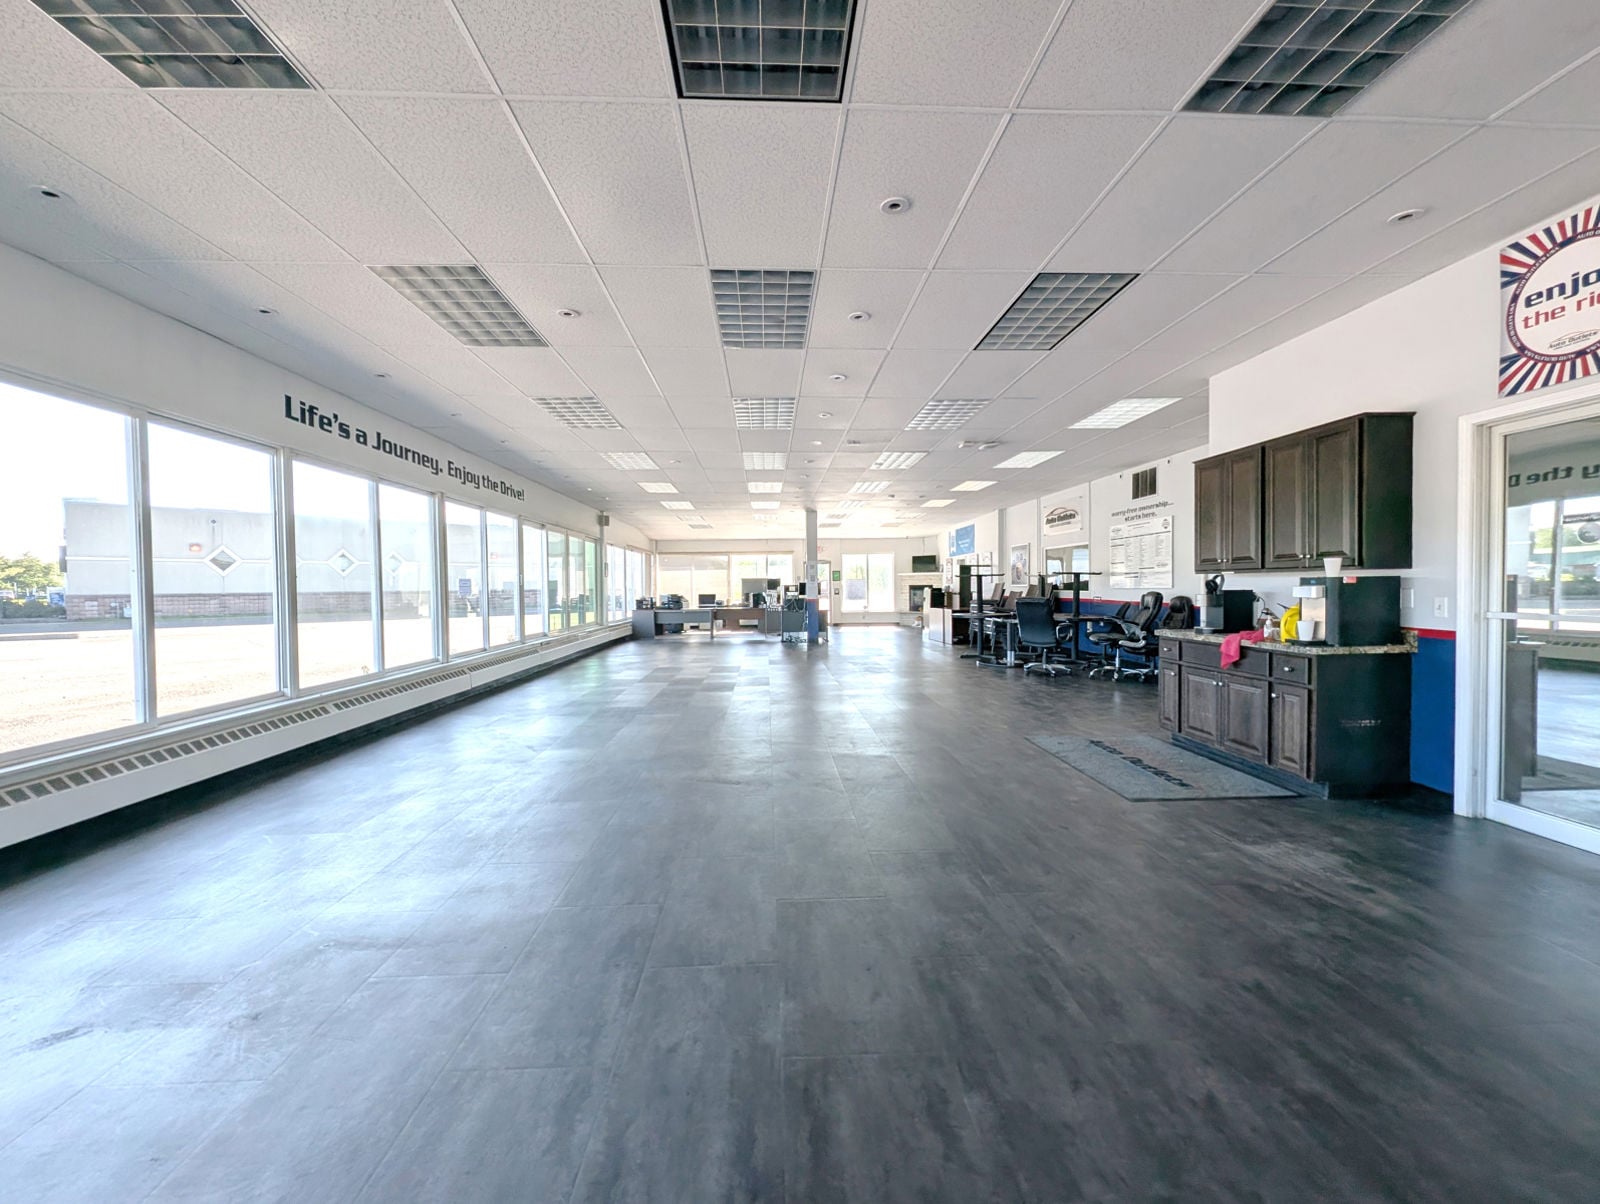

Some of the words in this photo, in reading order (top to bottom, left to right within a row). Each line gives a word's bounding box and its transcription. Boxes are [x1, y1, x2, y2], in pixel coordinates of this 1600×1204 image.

[1522, 305, 1566, 329] the
[1576, 291, 1600, 312] ri
[284, 394, 351, 440] Life's
[355, 428, 368, 447] a
[371, 431, 443, 476] Journey.
[447, 460, 480, 490] Enjoy
[482, 475, 499, 493] the
[500, 480, 525, 502] Drive!
